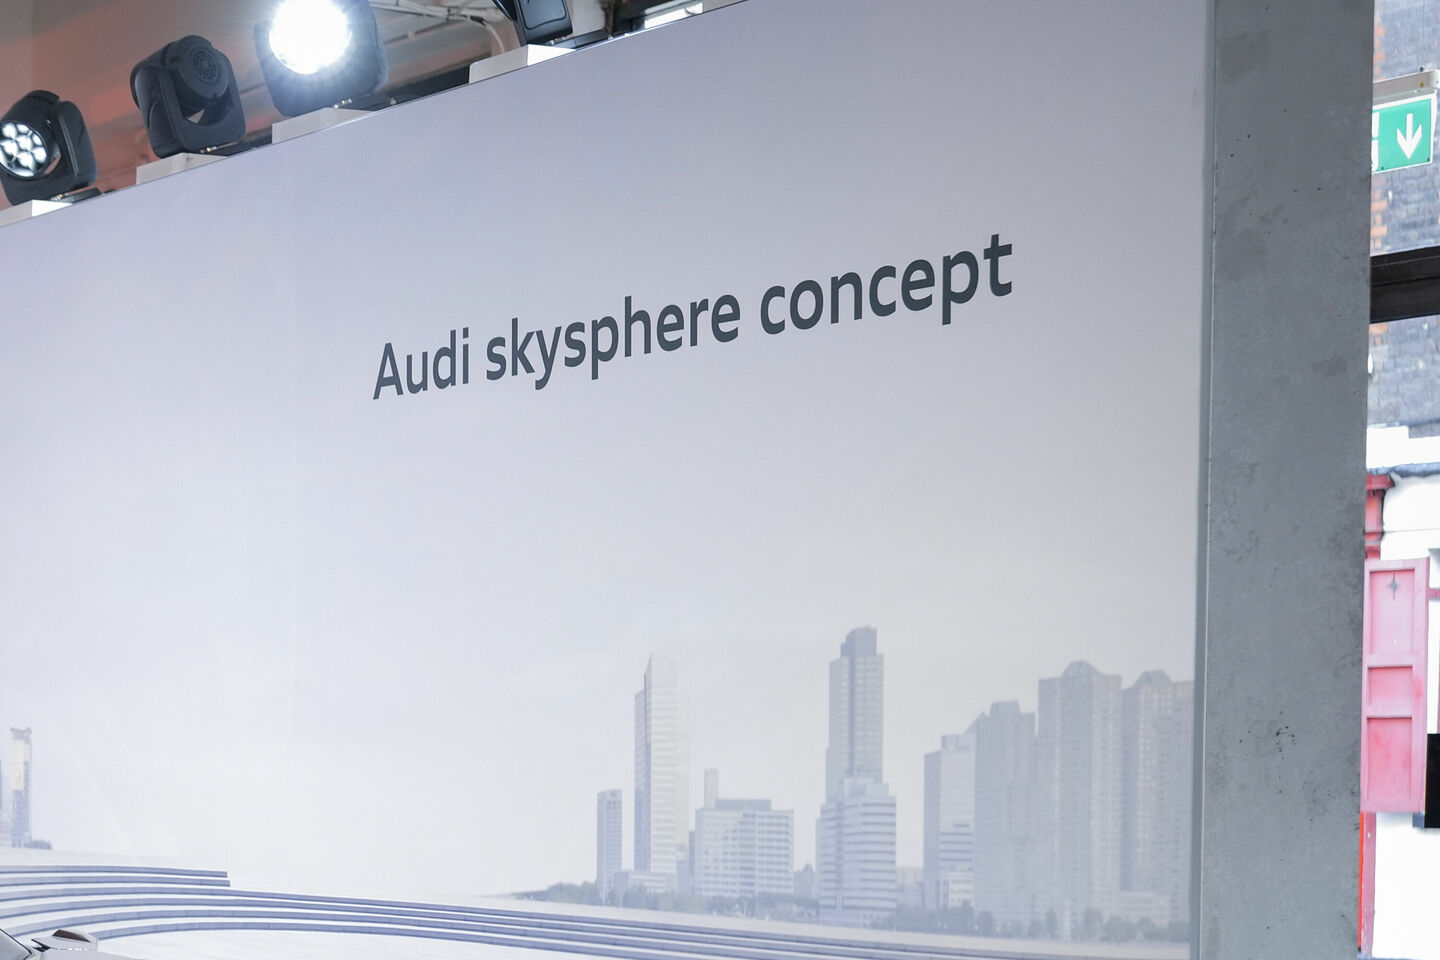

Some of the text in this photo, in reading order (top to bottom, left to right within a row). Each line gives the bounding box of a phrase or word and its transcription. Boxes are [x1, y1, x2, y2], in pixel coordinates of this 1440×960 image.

[372, 233, 1013, 400] Audi skysphere concept
